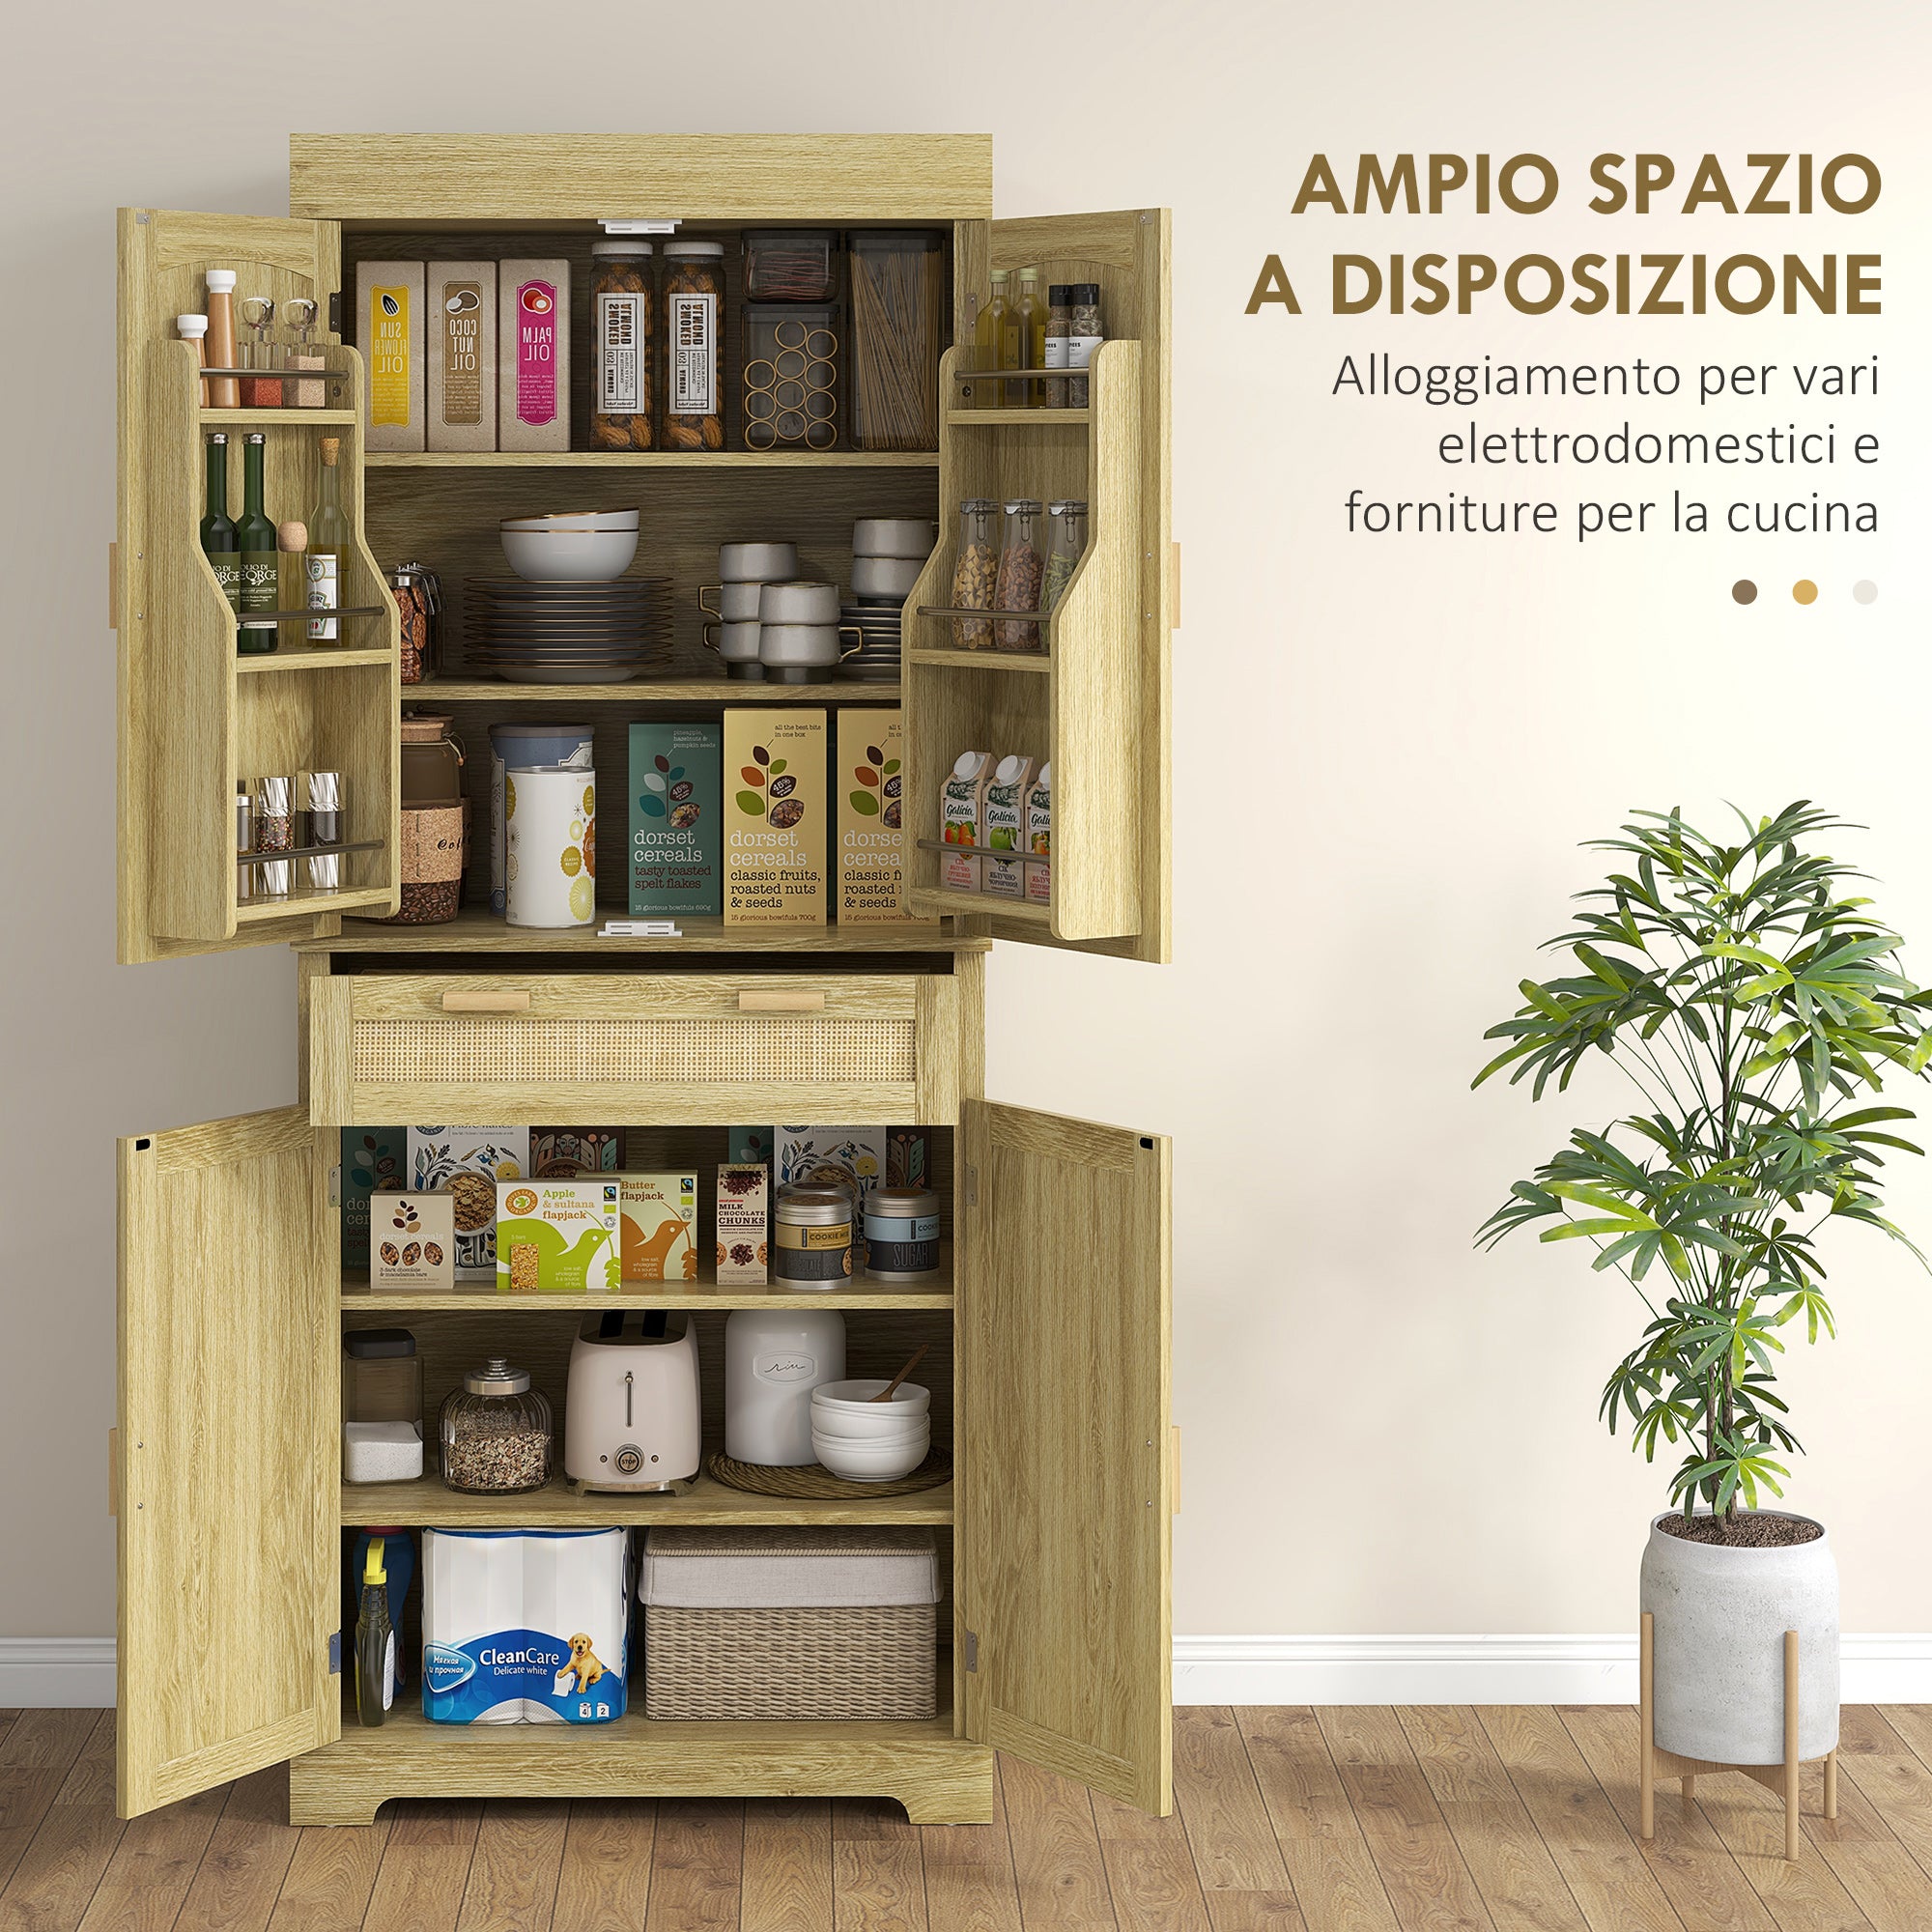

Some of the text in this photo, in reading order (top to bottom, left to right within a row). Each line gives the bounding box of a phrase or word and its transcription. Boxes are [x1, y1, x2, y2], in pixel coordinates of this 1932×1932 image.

[213, 571, 241, 582] ORGE
[240, 569, 277, 581] EORGE
[946, 803, 975, 818] Galicia
[987, 810, 1018, 824] Galicia
[1031, 812, 1051, 828] Gali
[634, 829, 696, 845] dorset
[729, 829, 799, 847] dorset
[843, 829, 902, 847] dorse
[634, 847, 703, 863] cereals
[729, 849, 808, 867] cereals
[843, 852, 902, 867] cerea
[635, 865, 712, 878] tasty toasted
[730, 869, 821, 882] classic fruits,
[844, 869, 890, 881] classic
[635, 877, 702, 891] spelt flakes
[730, 883, 816, 895] roasted nuts
[844, 883, 895, 895] roasted
[730, 896, 783, 908] & seeds
[844, 896, 896, 908] & seeds
[621, 1180, 656, 1189] Butter
[542, 1189, 576, 1200] Apple
[620, 1191, 665, 1202] flapjack
[542, 1200, 595, 1208] & sultana
[542, 1210, 587, 1221] flapjack
[894, 1243, 928, 1267] SUGAR
[479, 1647, 560, 1666] CleanCare
[494, 1666, 549, 1677] Delicate white
[582, 1708, 587, 1717] 4
